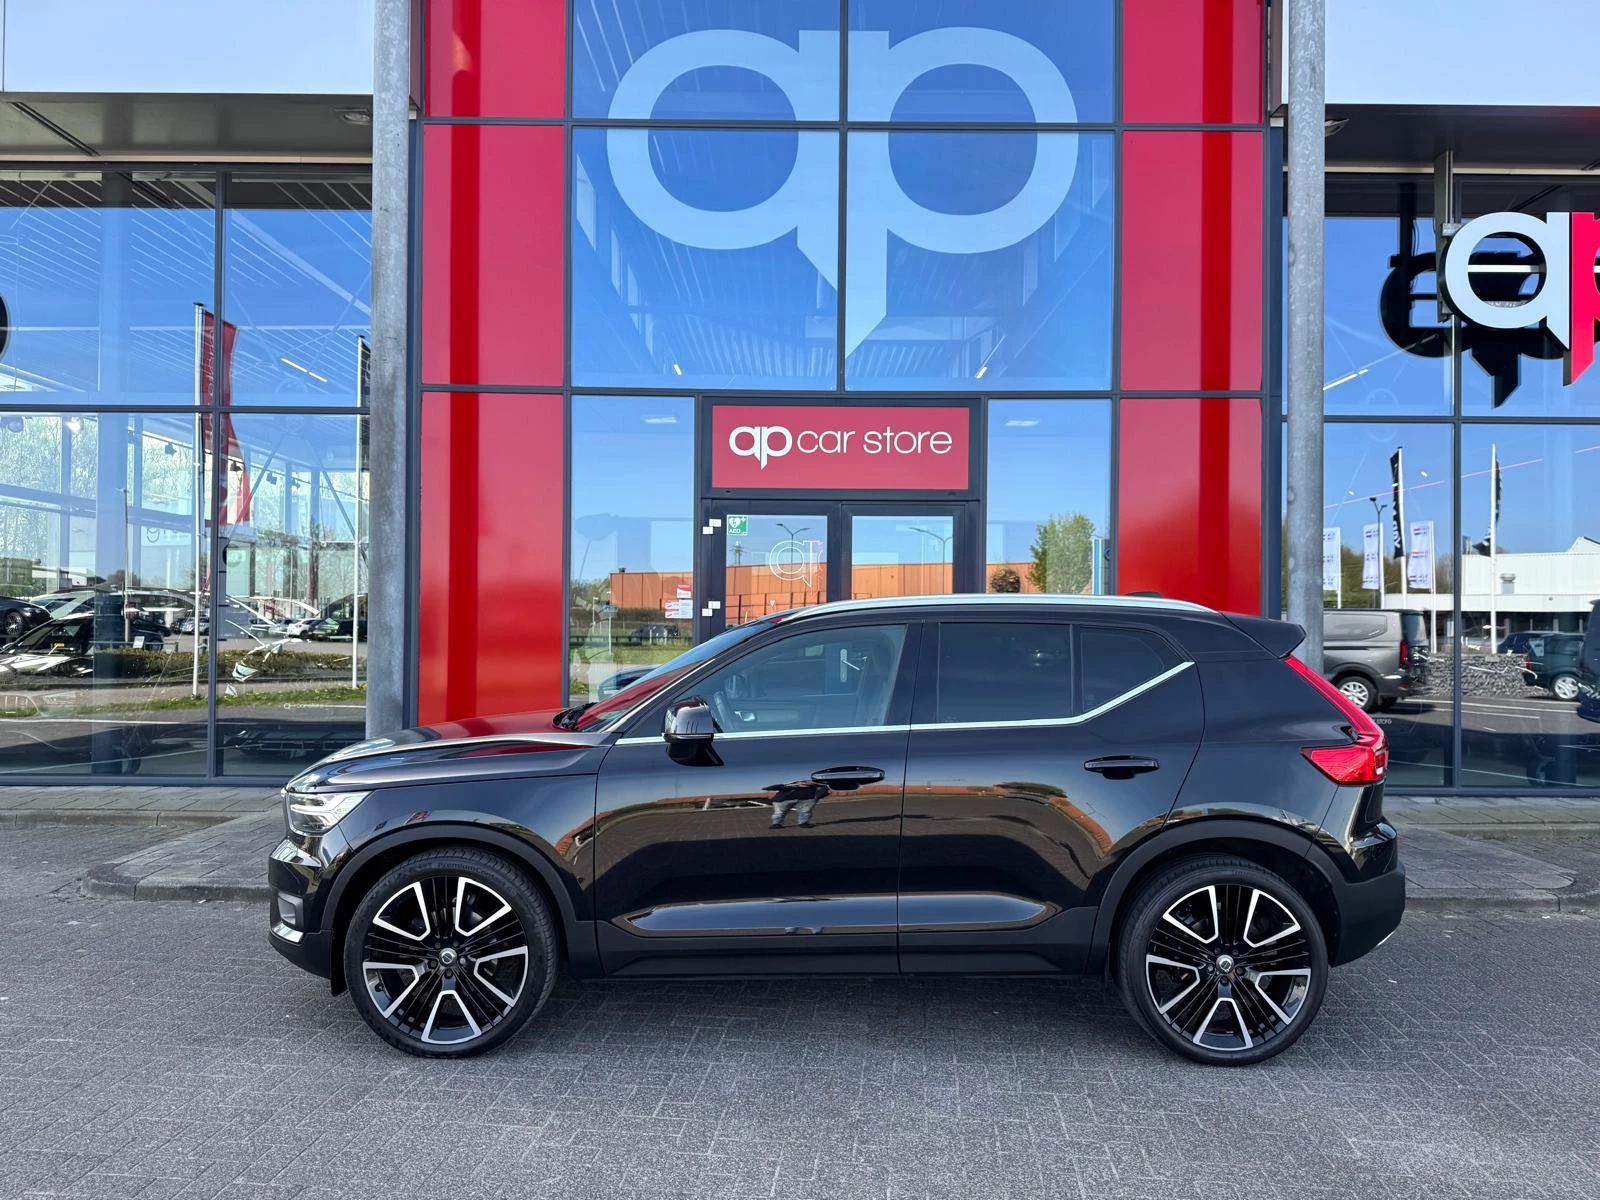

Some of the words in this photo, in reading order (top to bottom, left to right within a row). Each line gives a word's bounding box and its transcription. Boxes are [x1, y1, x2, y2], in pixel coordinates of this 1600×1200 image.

[607, 27, 1079, 358] ap
[728, 425, 792, 470] ap
[796, 430, 855, 454] car
[863, 425, 952, 454] store
